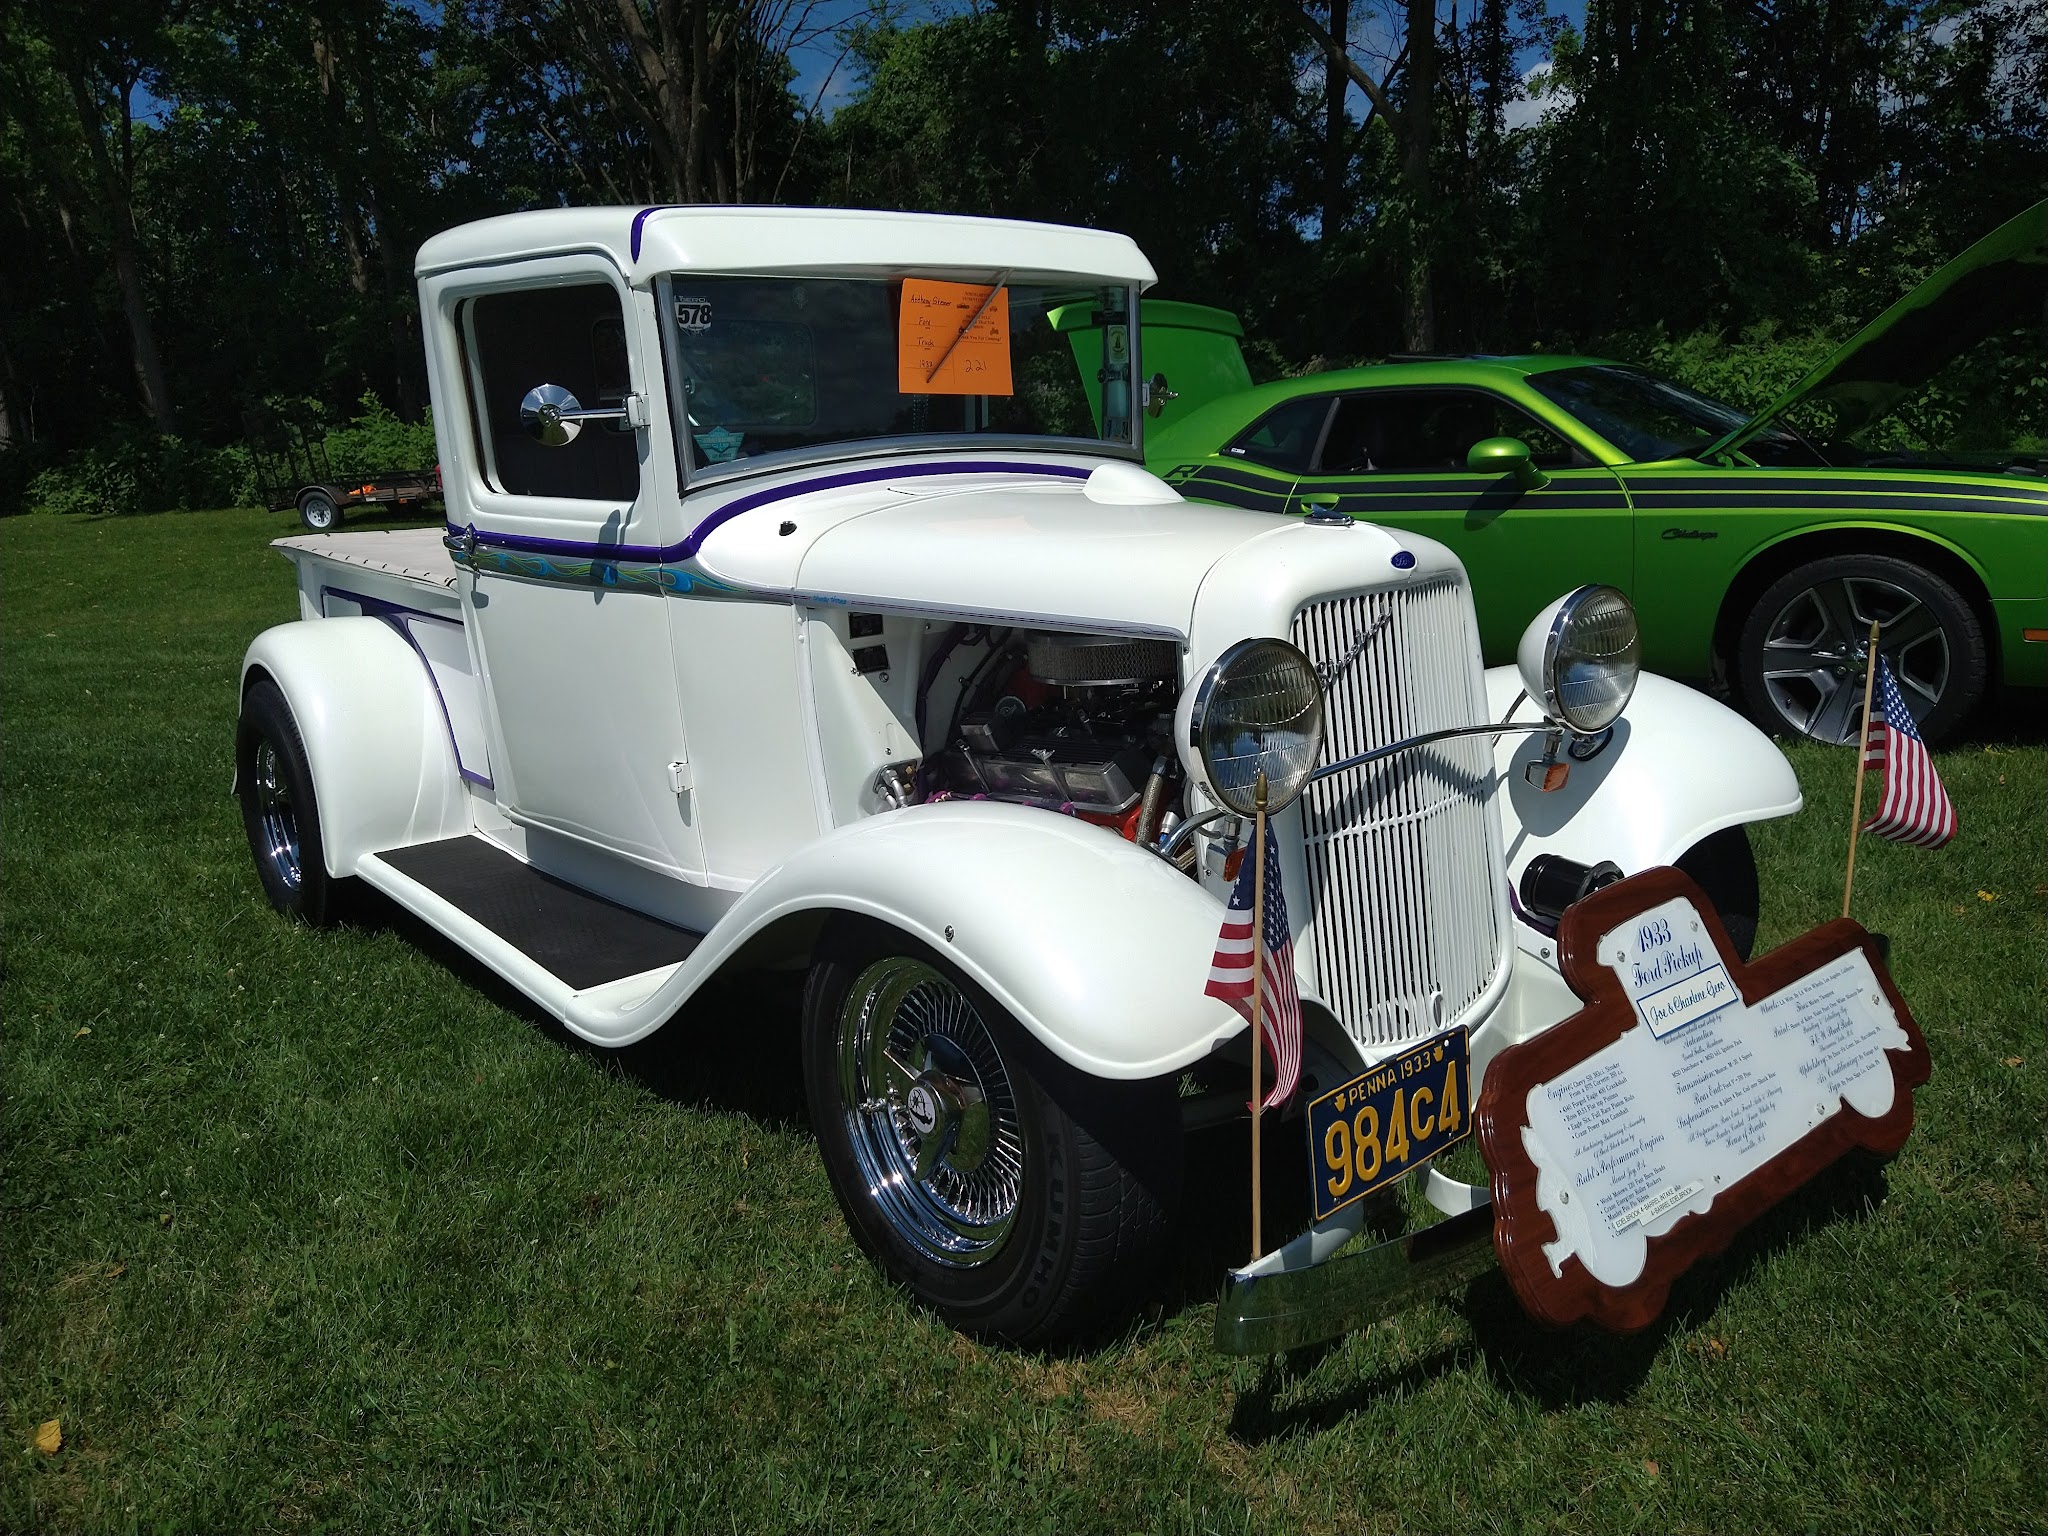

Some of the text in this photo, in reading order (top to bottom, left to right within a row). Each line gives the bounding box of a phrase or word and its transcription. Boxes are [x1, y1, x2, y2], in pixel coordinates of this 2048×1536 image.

[678, 304, 711, 325] 578
[918, 317, 931, 326] Ford
[917, 337, 935, 346] Truck
[965, 360, 987, 373] 221
[1638, 918, 1672, 953] 1933
[1632, 942, 1704, 988] Ford Pickup
[1649, 1005, 1669, 1025] Joe
[1669, 1002, 1675, 1015] &
[1673, 989, 1708, 1012] Charlene
[1349, 1051, 1431, 1106] PENNA 1933
[1325, 1060, 1461, 1197] 984C4
[1021, 1132, 1065, 1309] KUMHO
